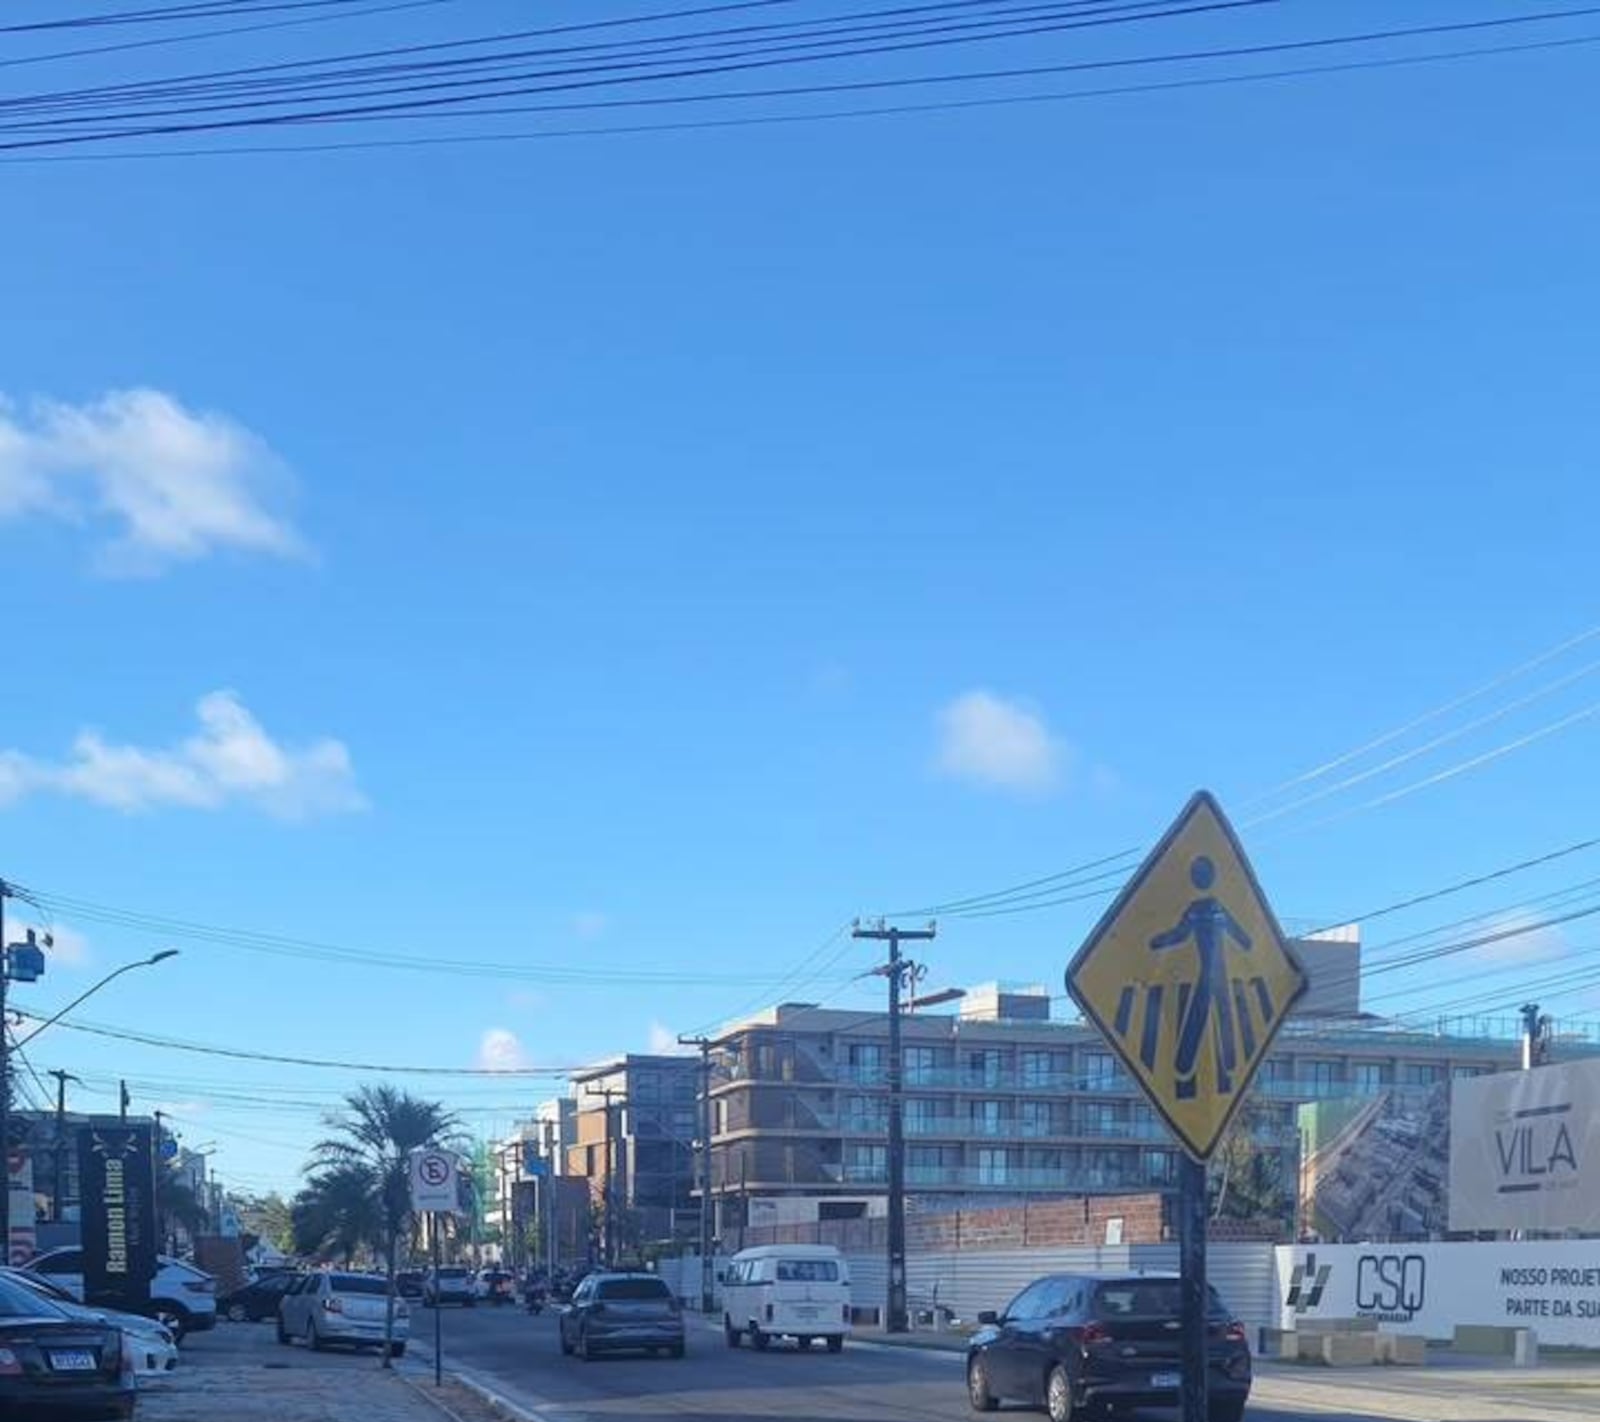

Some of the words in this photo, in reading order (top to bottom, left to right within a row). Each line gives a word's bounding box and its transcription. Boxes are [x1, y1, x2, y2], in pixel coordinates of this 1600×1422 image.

[1495, 1122, 1578, 1175] VILA
[104, 1158, 125, 1203] Lima
[105, 1207, 126, 1273] Ramon
[1356, 1254, 1426, 1321] CSQ
[1501, 1268, 1547, 1286] NOSSO
[1506, 1297, 1549, 1316] PARTE
[1553, 1299, 1572, 1317] DA
